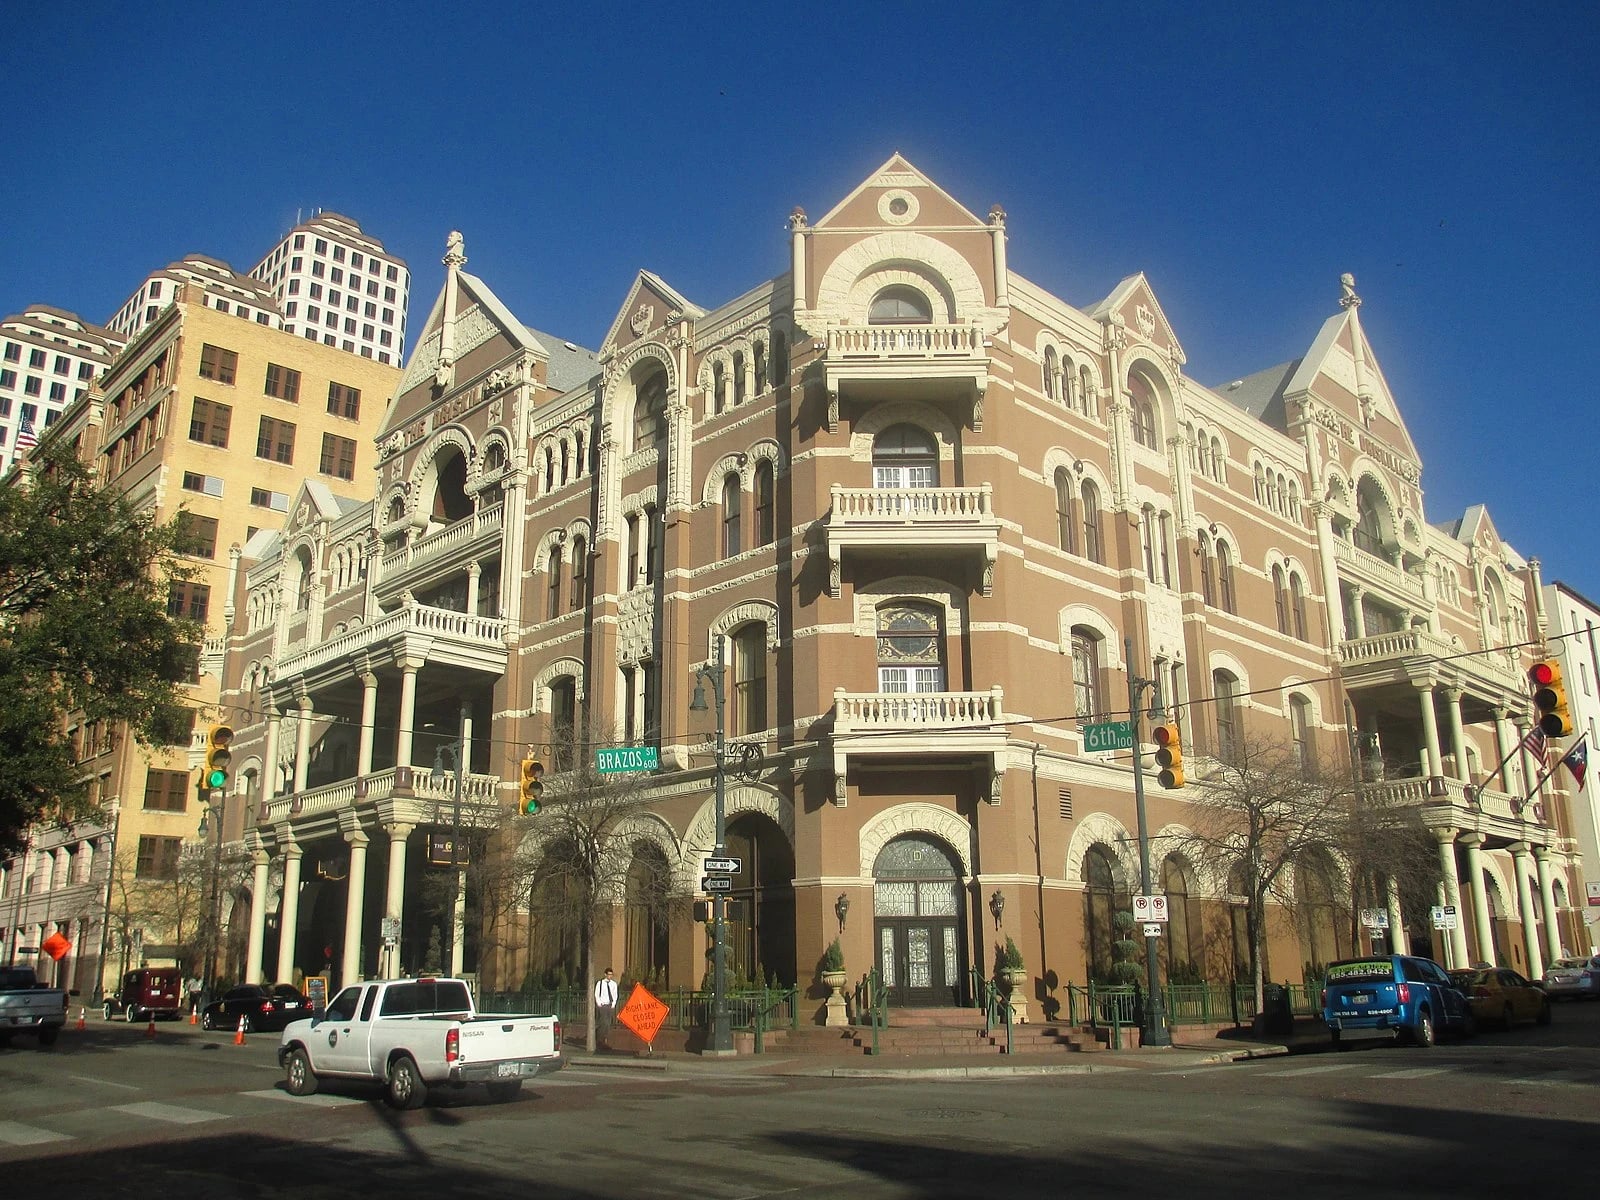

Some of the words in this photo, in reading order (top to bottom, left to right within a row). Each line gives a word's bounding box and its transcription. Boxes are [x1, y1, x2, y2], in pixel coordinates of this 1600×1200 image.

[1090, 726, 1116, 747] 6th
[1120, 721, 1131, 732] ST
[1117, 736, 1133, 748] 100
[598, 750, 643, 770] BRAZOS
[646, 747, 655, 756] ST
[643, 759, 657, 768] 600
[644, 1002, 659, 1010] LANE
[633, 1012, 655, 1022] CLOSED
[637, 1022, 656, 1031] AHEAD
